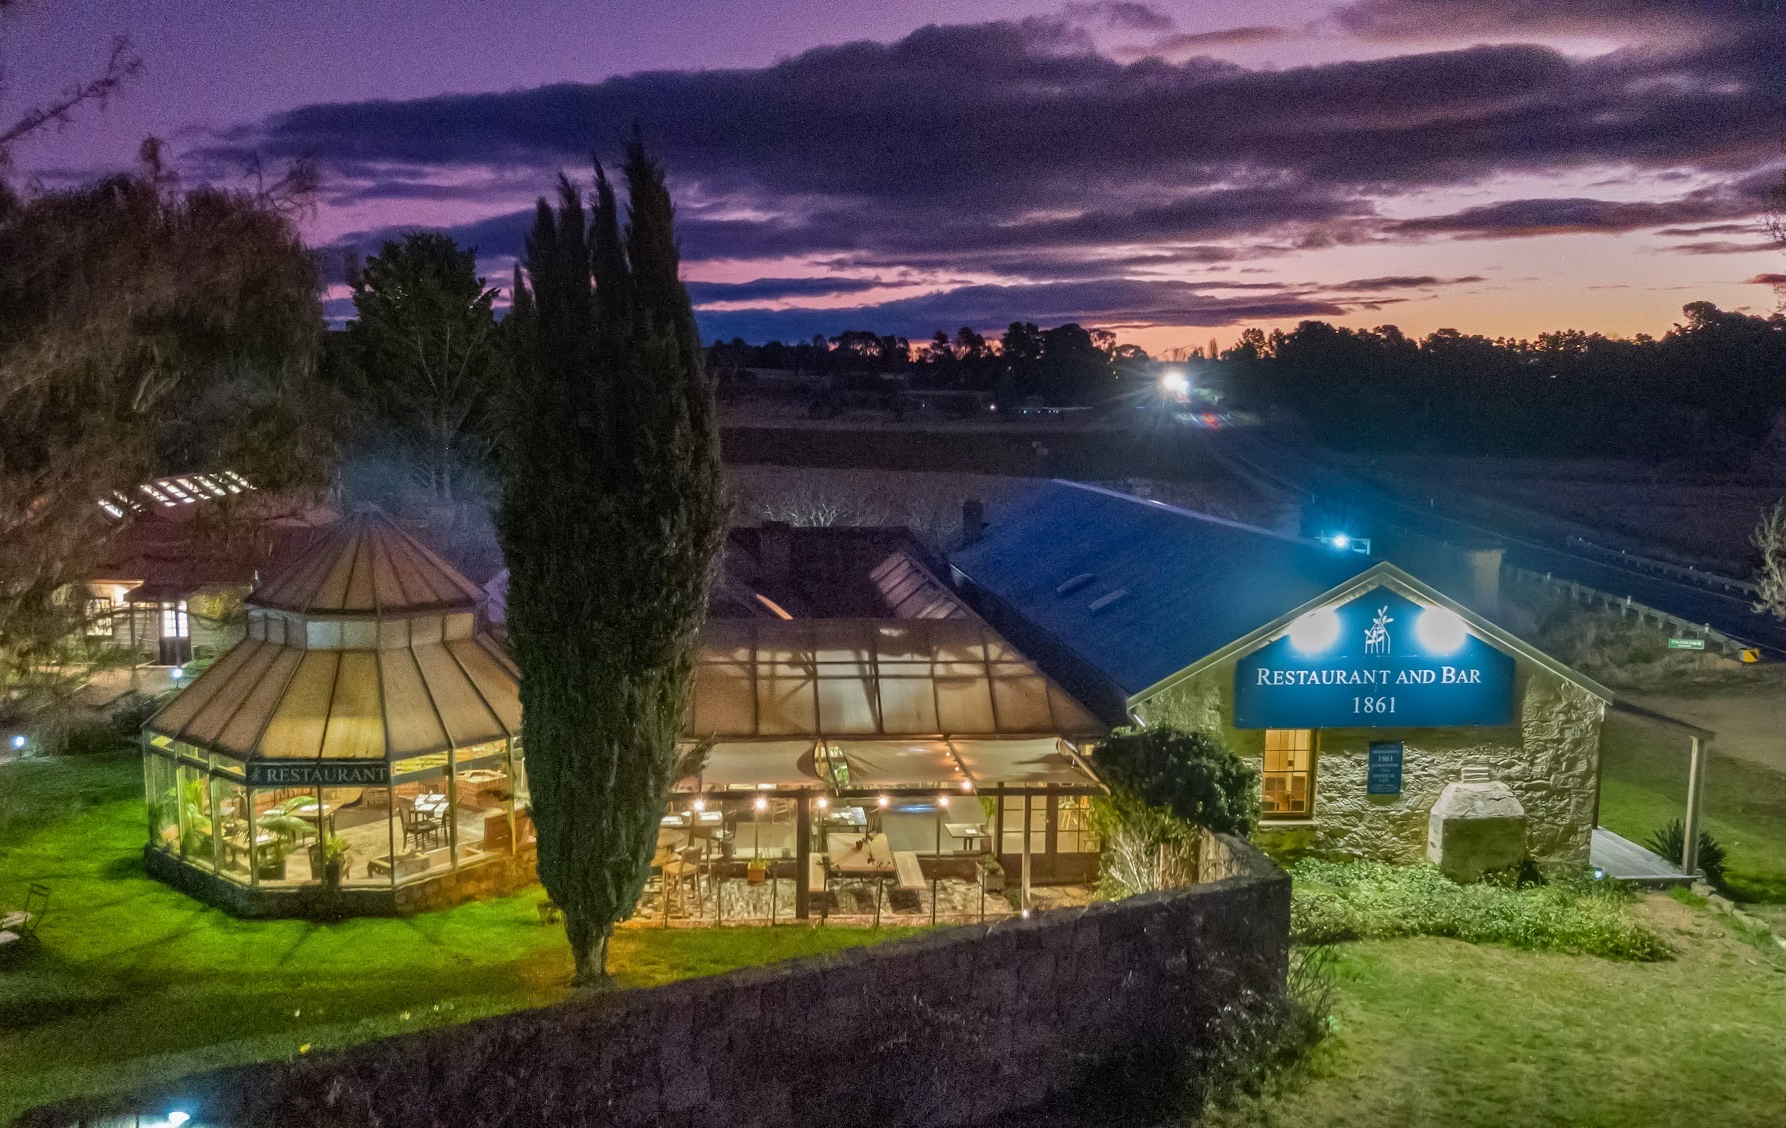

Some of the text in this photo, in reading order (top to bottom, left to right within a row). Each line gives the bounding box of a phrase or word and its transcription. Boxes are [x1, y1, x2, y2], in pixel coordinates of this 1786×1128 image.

[1256, 666, 1481, 685] RESTAURANT AND BAR
[1353, 696, 1395, 713] 1861
[267, 767, 387, 783] RESTAURANT
